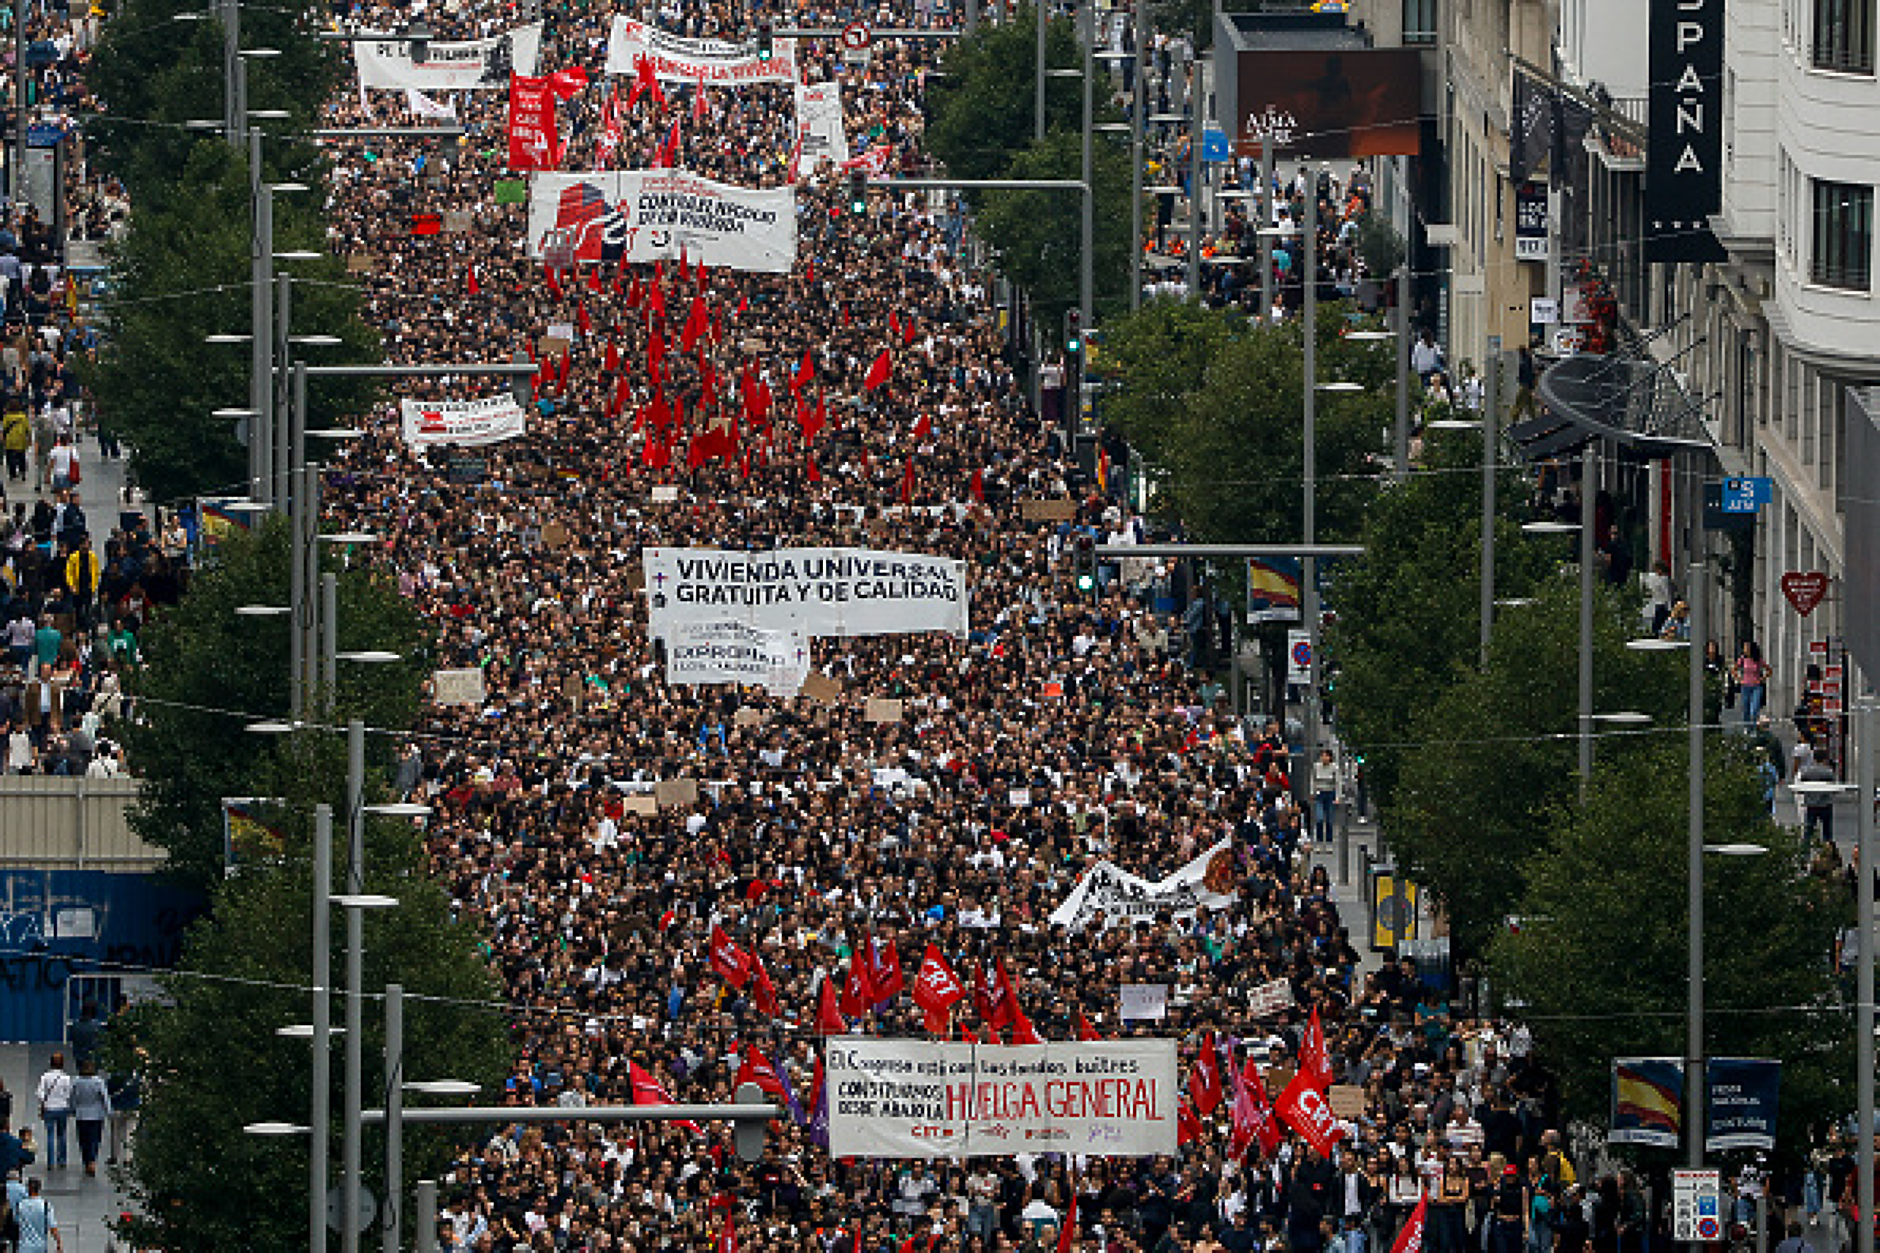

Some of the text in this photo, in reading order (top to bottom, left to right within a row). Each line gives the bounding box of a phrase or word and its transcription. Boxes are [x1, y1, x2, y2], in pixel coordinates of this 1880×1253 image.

[676, 556, 954, 584] VIVIENDA UNIVERSAL
[676, 581, 959, 605] GRATUITA Y DE CALIDAD
[1075, 1056, 1140, 1075] buitres
[838, 1101, 944, 1121] DESDE ABAJO LA
[945, 1078, 1165, 1121] HUELGA GENERAL
